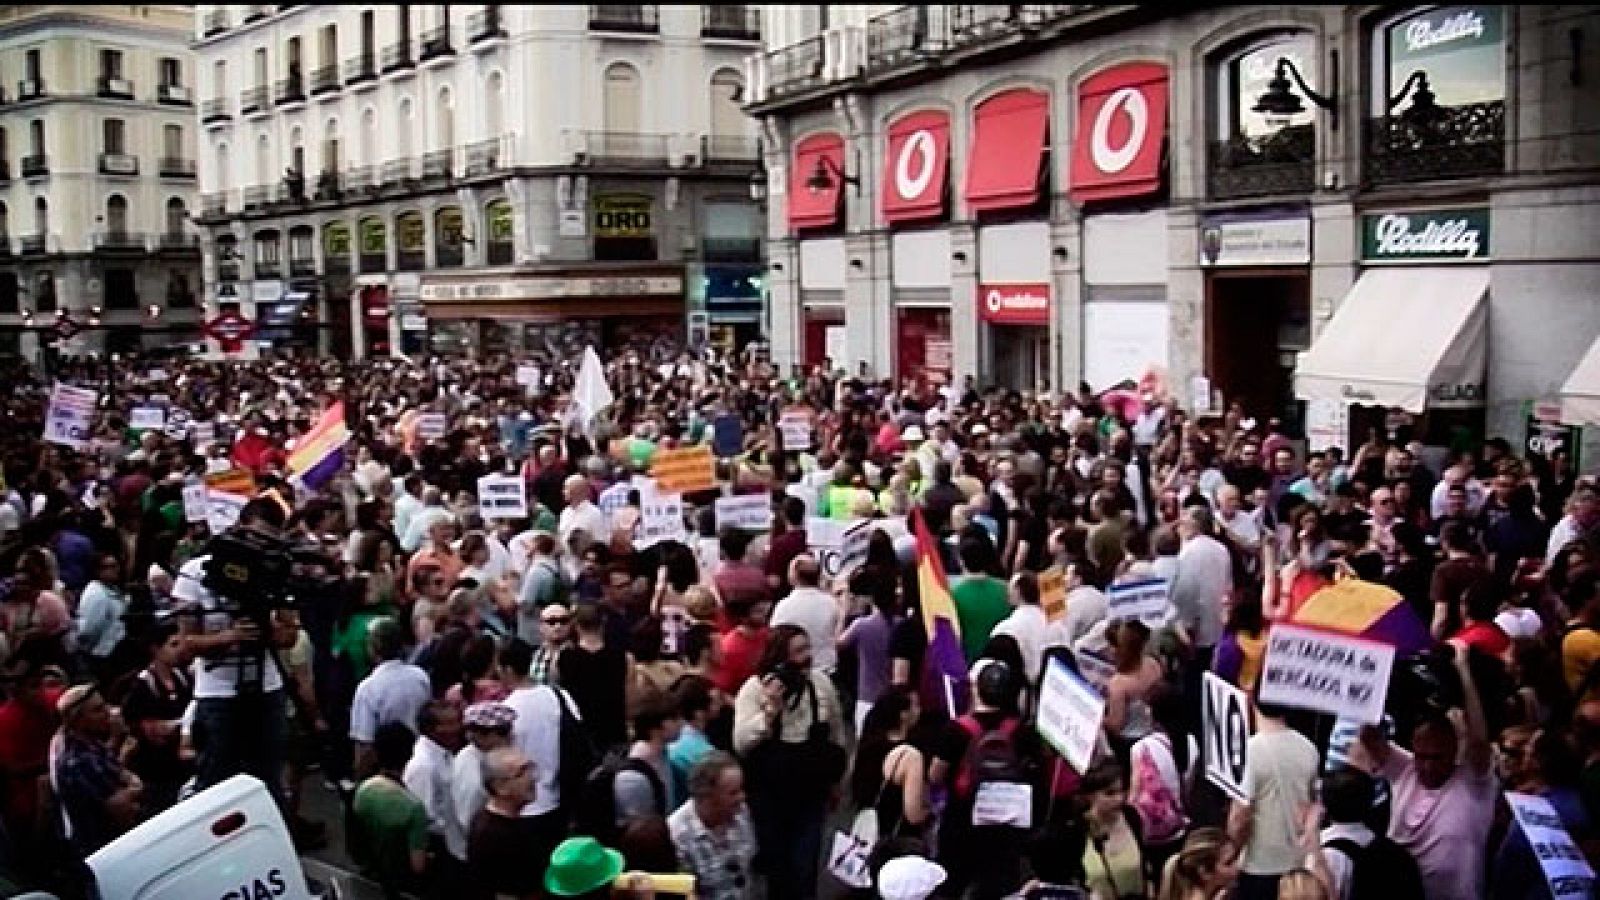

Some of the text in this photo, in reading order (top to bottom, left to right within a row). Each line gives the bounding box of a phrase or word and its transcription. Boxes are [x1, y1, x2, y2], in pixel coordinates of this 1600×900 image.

[597, 211, 650, 229] ORO
[1376, 214, 1480, 259] Rodilla
[1003, 293, 1048, 309] vodafone
[1203, 676, 1246, 788] NO
